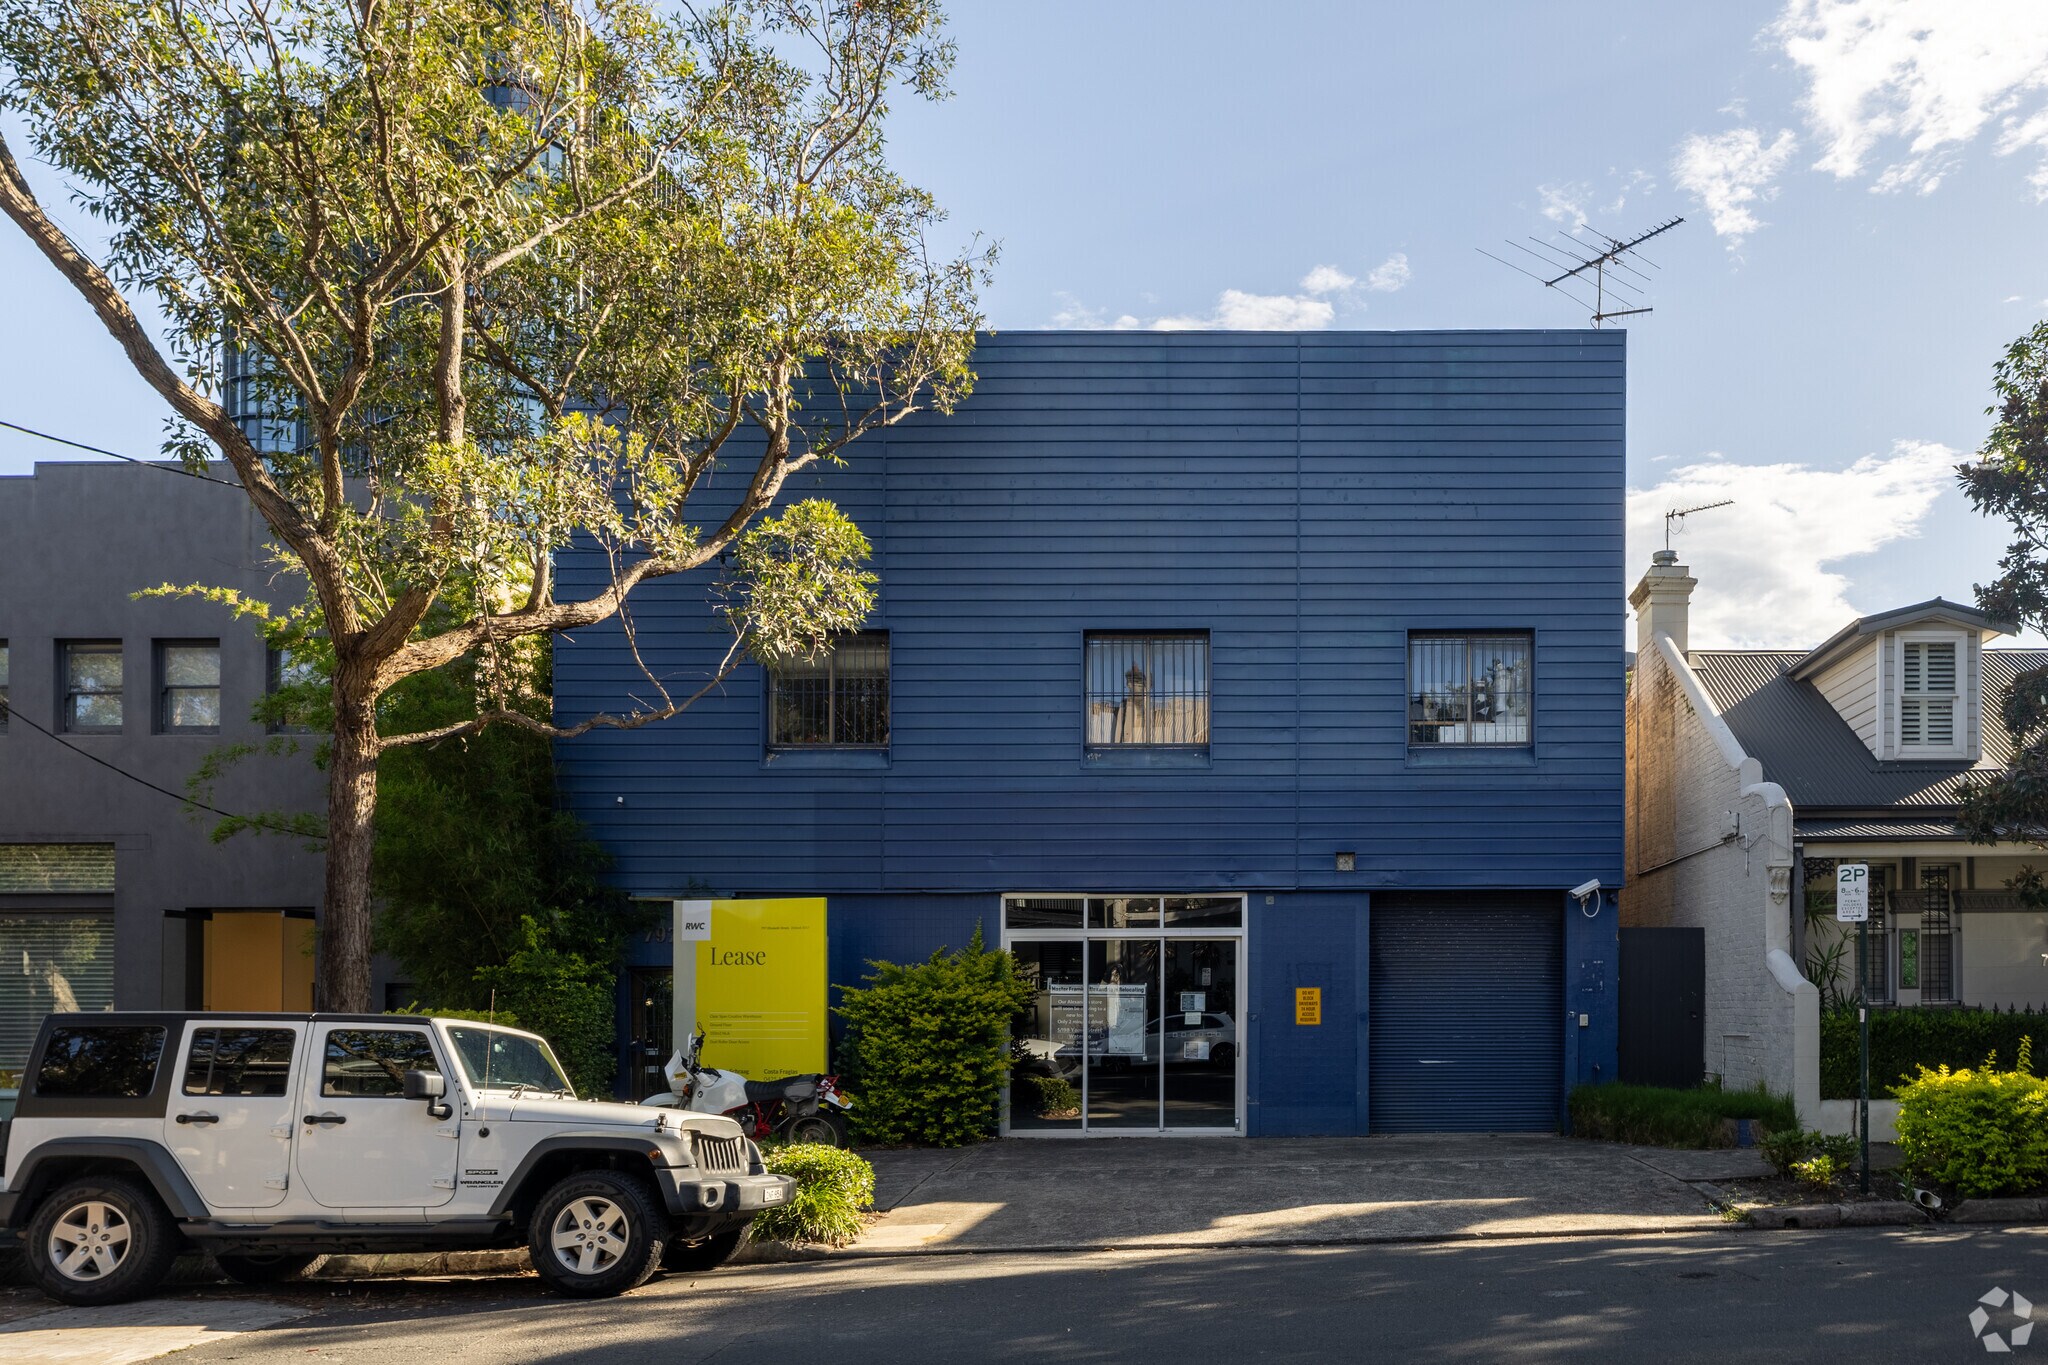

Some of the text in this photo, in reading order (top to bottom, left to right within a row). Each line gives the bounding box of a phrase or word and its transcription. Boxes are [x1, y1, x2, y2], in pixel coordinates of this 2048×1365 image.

[1840, 868, 1865, 882] 2P
[685, 922, 706, 930] RWC
[711, 947, 766, 966] Lease
